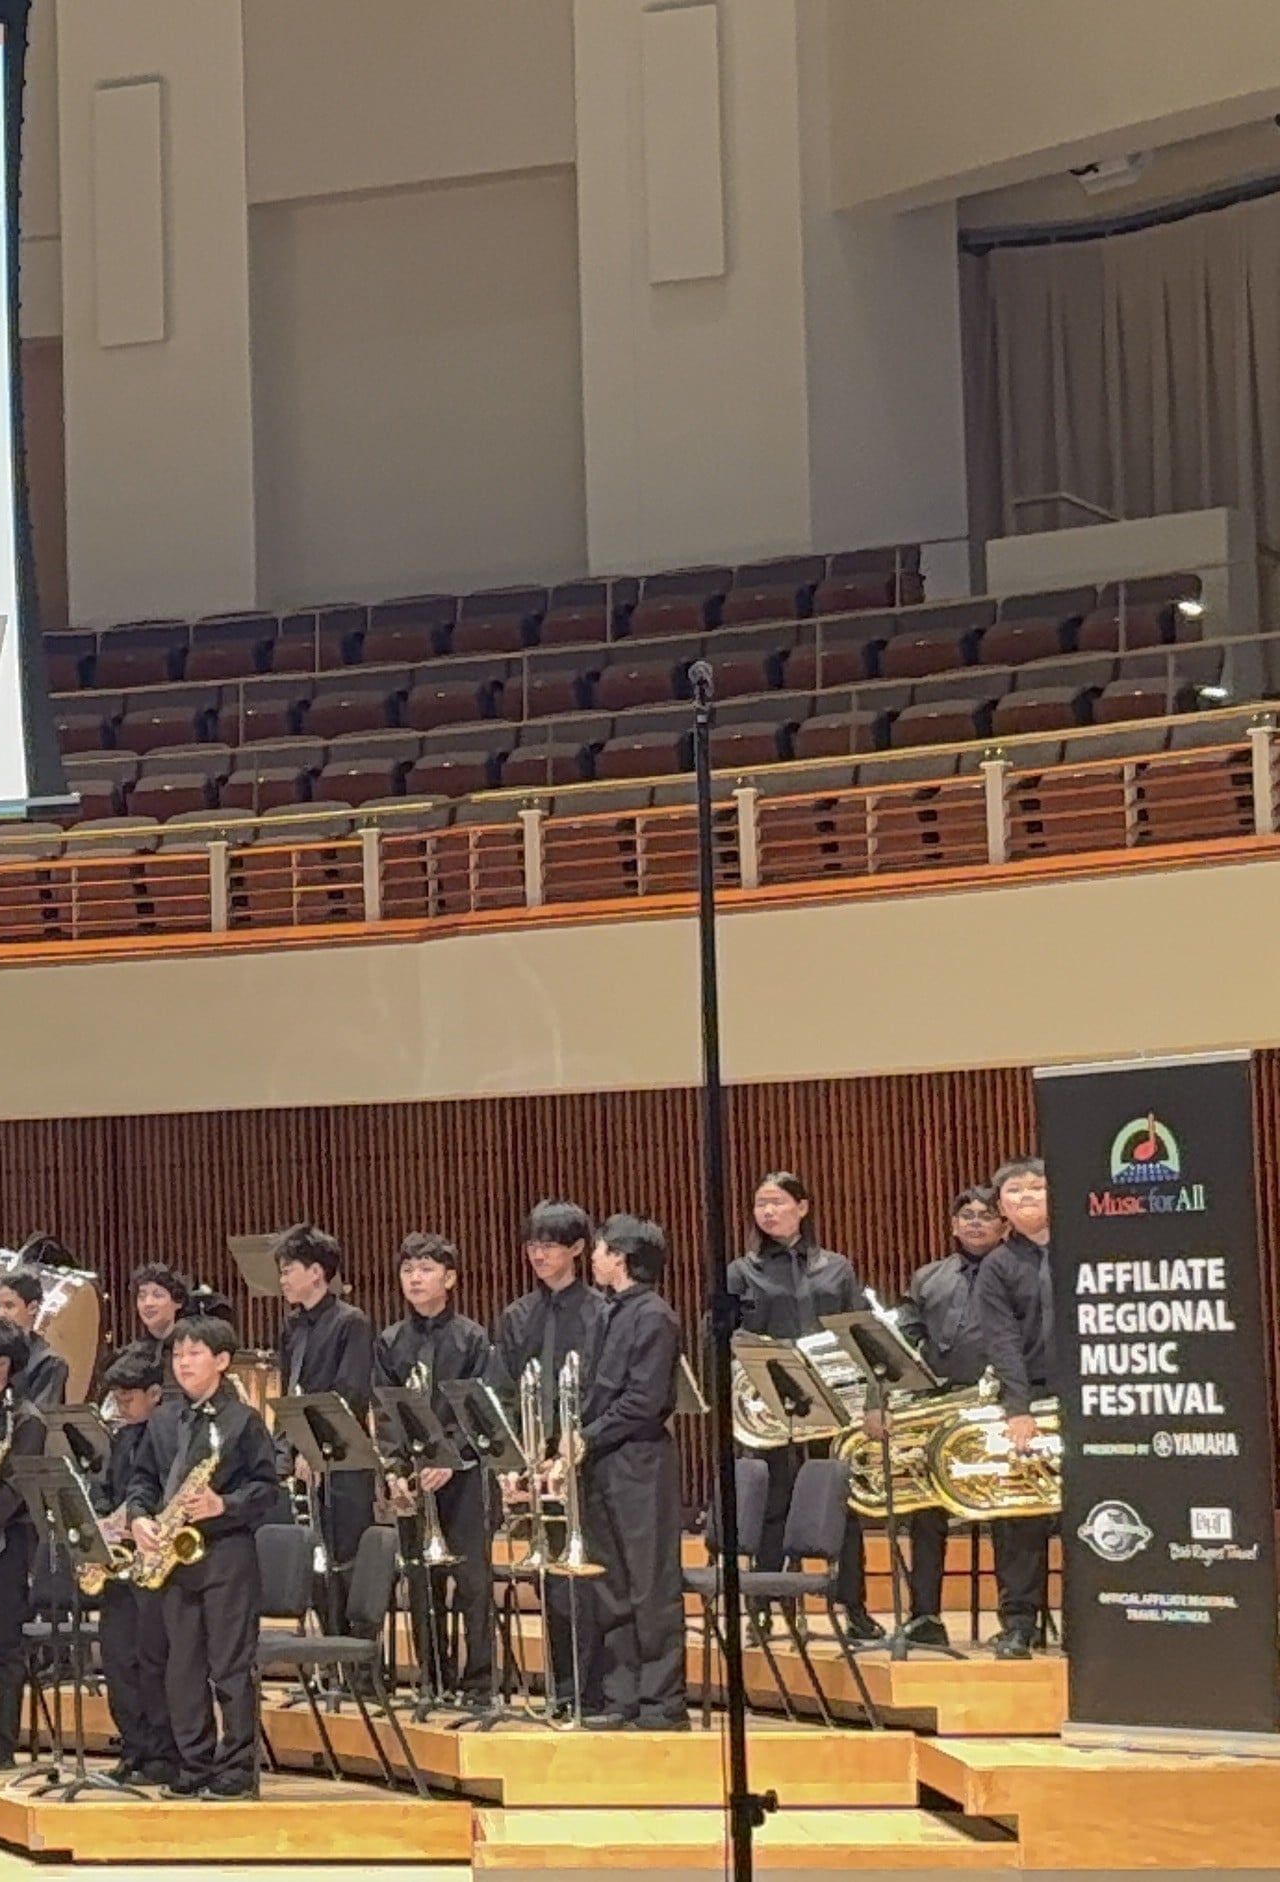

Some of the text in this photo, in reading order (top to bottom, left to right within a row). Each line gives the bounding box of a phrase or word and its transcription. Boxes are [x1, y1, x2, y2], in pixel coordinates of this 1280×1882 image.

[1088, 1184, 1206, 1216] Music for All
[1076, 1257, 1226, 1294] AFFILIATE
[1077, 1300, 1235, 1335] REGIONAL
[1080, 1342, 1179, 1376] MUSIC
[1081, 1382, 1225, 1416] FESTIVAL
[1172, 1432, 1240, 1457] YAMAHA
